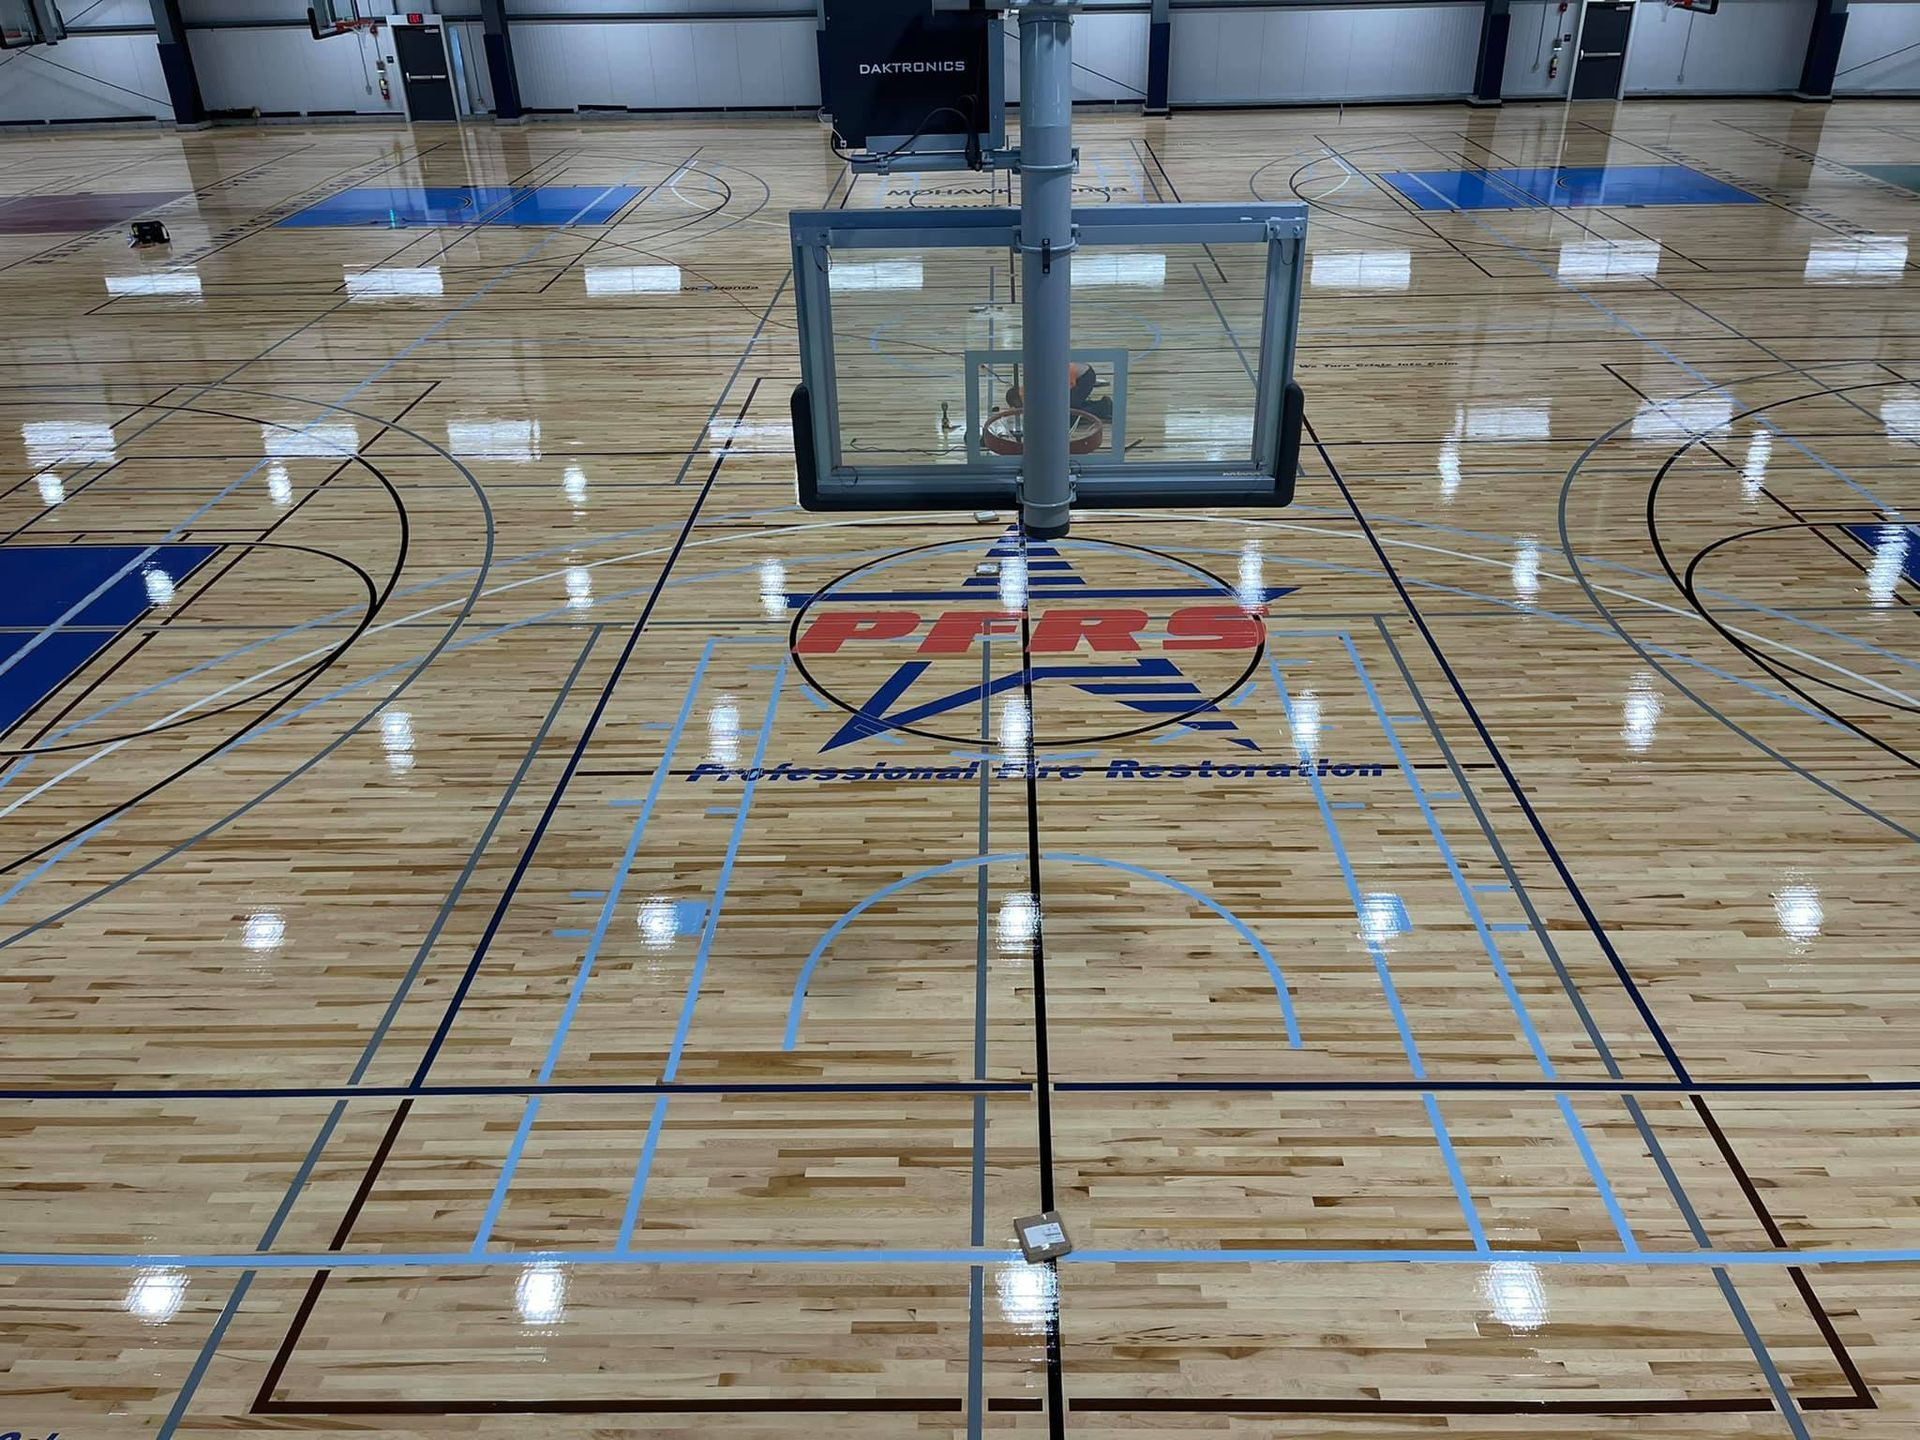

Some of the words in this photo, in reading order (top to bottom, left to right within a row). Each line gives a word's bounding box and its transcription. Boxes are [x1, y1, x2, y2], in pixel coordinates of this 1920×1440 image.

[860, 61, 965, 75] DAKTRONICS
[887, 188, 1012, 196] MOHAWK
[791, 606, 1269, 653] PFRS
[685, 761, 980, 782] Professional
[1105, 759, 1383, 779] Restoration
